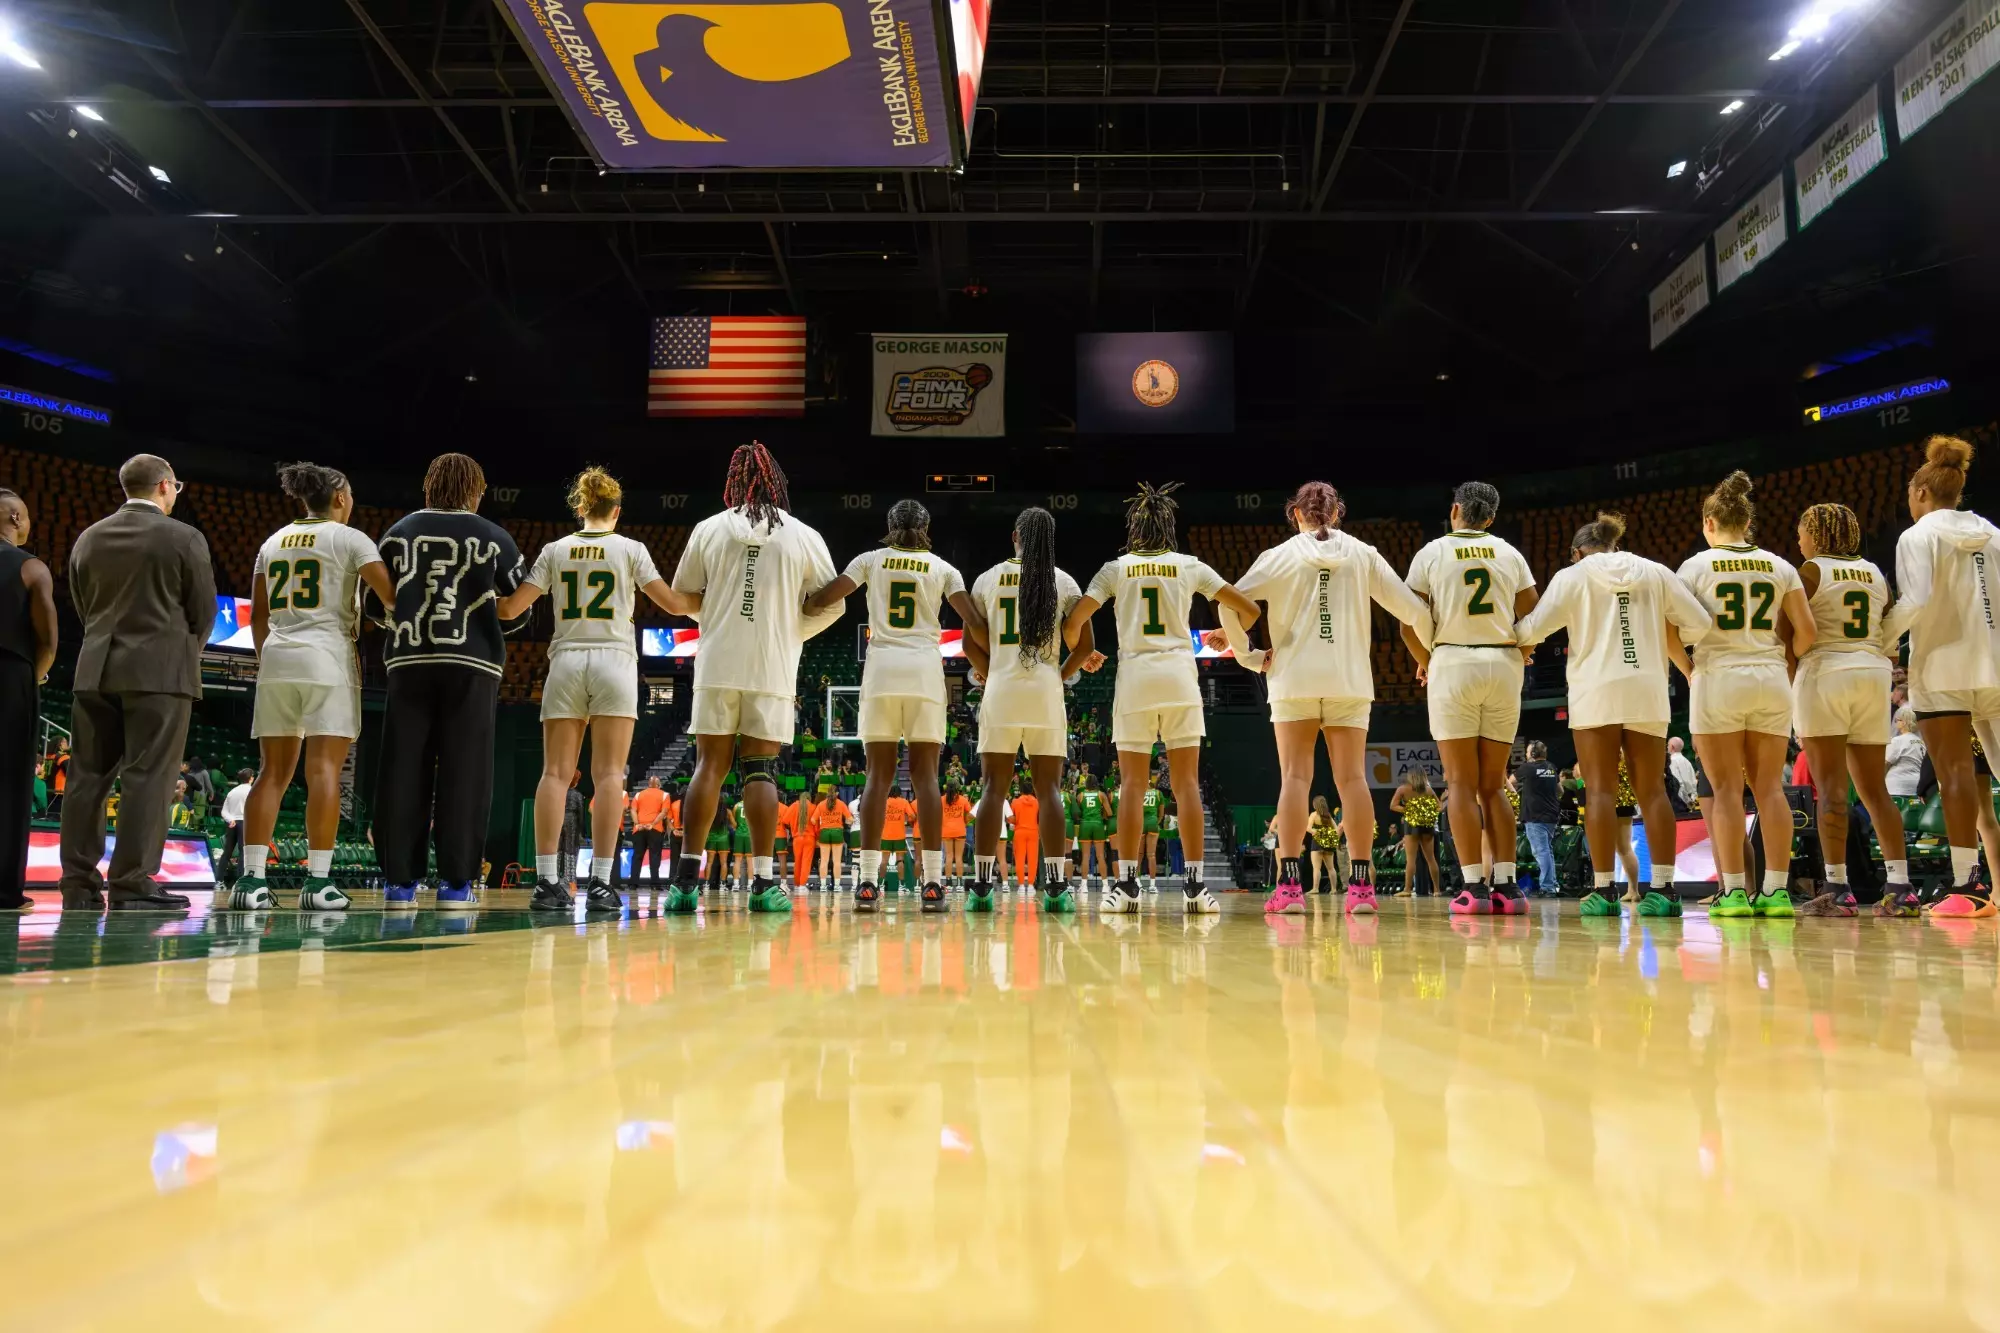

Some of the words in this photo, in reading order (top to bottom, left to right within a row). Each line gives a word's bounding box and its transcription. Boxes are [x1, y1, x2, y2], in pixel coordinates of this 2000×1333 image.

[898, 21, 918, 81] UNIVERSITY
[543, 28, 571, 64] MASON
[565, 62, 603, 118] UNIVERSITY
[878, 54, 916, 146] EAGLEBANK
[908, 79, 923, 111] MASON
[594, 94, 638, 146] ARENA
[914, 110, 929, 143] GEORGE
[1825, 119, 1877, 174] BASKETBALL
[1830, 166, 1848, 190] 1999
[876, 341, 940, 354] GEORGE
[944, 341, 1003, 354] MASON
[912, 380, 967, 393] FINAL
[893, 392, 968, 409] FOUR
[1820, 391, 1897, 417] EAGLEBANK
[1899, 379, 1949, 399] ARENA
[21, 411, 63, 434] 105
[62, 403, 109, 423] ARENA
[1876, 405, 1910, 427] 112
[1614, 461, 1637, 480] 111
[492, 486, 521, 503] 107
[660, 494, 689, 509] 107
[841, 494, 872, 509] 108
[1047, 494, 1078, 509] 109
[1235, 494, 1261, 509] 110
[280, 534, 316, 549] KEYES
[569, 547, 605, 560] MOTTA
[1455, 547, 1495, 560] WALTON
[882, 558, 929, 573] JOHNSON
[1126, 564, 1177, 578] LITTLEJOHN
[1712, 560, 1774, 573] GREENBURG
[268, 559, 322, 610] 23
[1832, 568, 1873, 584] HARRIS
[561, 570, 615, 620] 12
[1463, 567, 1494, 616] 2
[888, 581, 916, 629] 5
[1140, 586, 1166, 636] 1
[1715, 582, 1775, 630] 32
[1843, 590, 1870, 639] 3
[1397, 764, 1443, 776] AEN
[1143, 796, 1156, 806] 20
